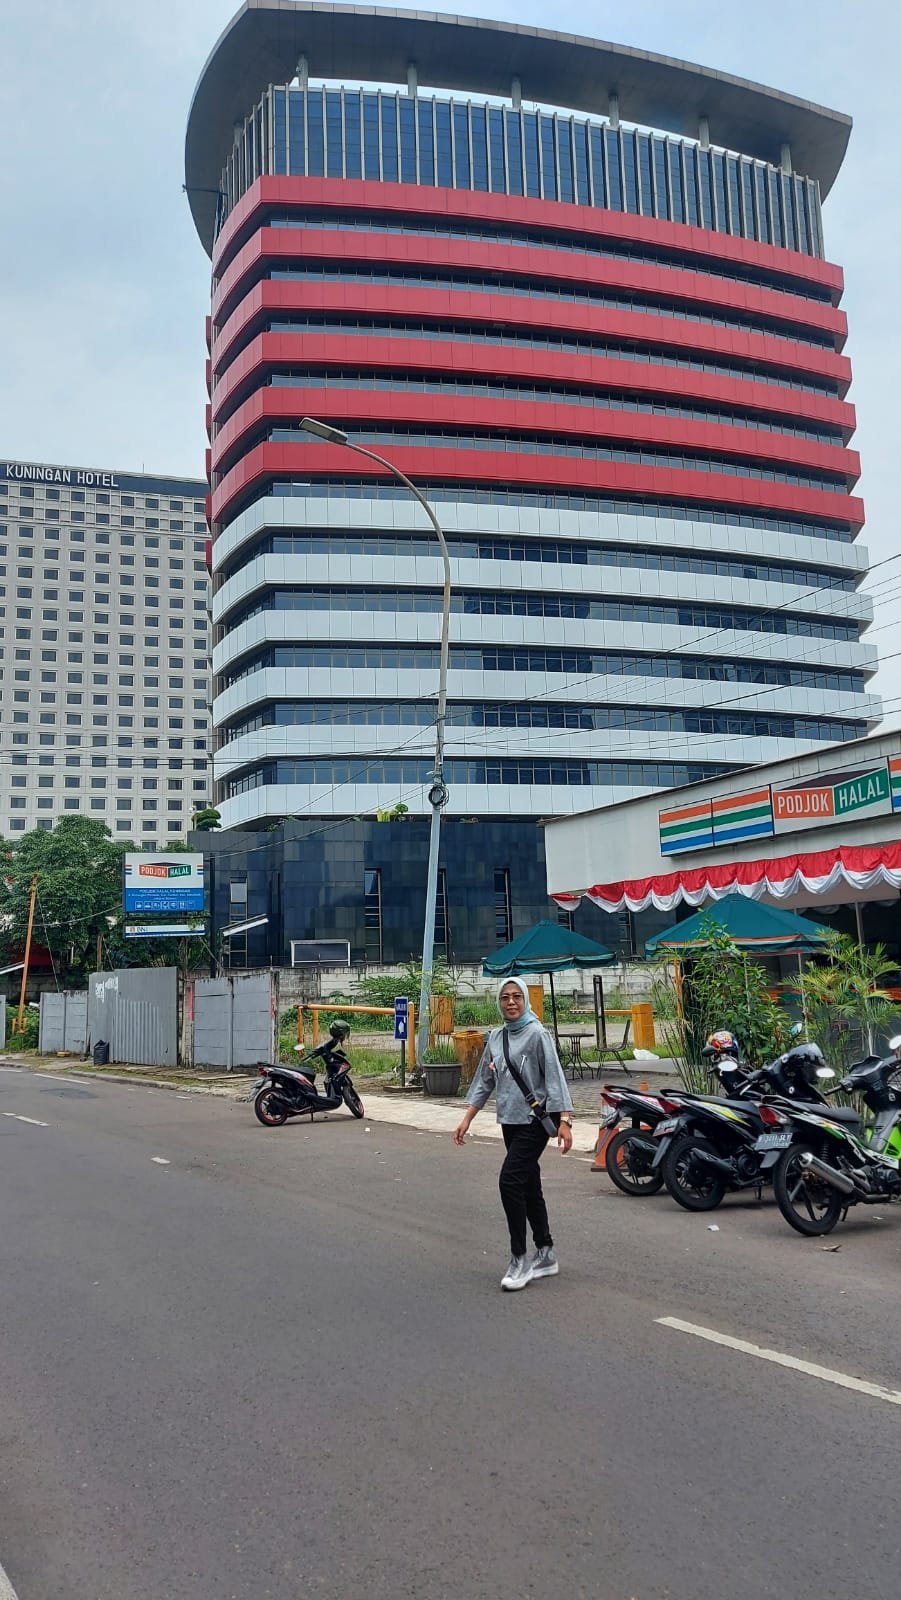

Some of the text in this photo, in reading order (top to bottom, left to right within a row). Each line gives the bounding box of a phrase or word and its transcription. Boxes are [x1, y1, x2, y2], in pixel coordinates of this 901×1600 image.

[6, 464, 119, 487] KUNINGAN HOTEL
[778, 777, 885, 814] PODJOK HALAL
[141, 866, 190, 877] PODJOK HALAL
